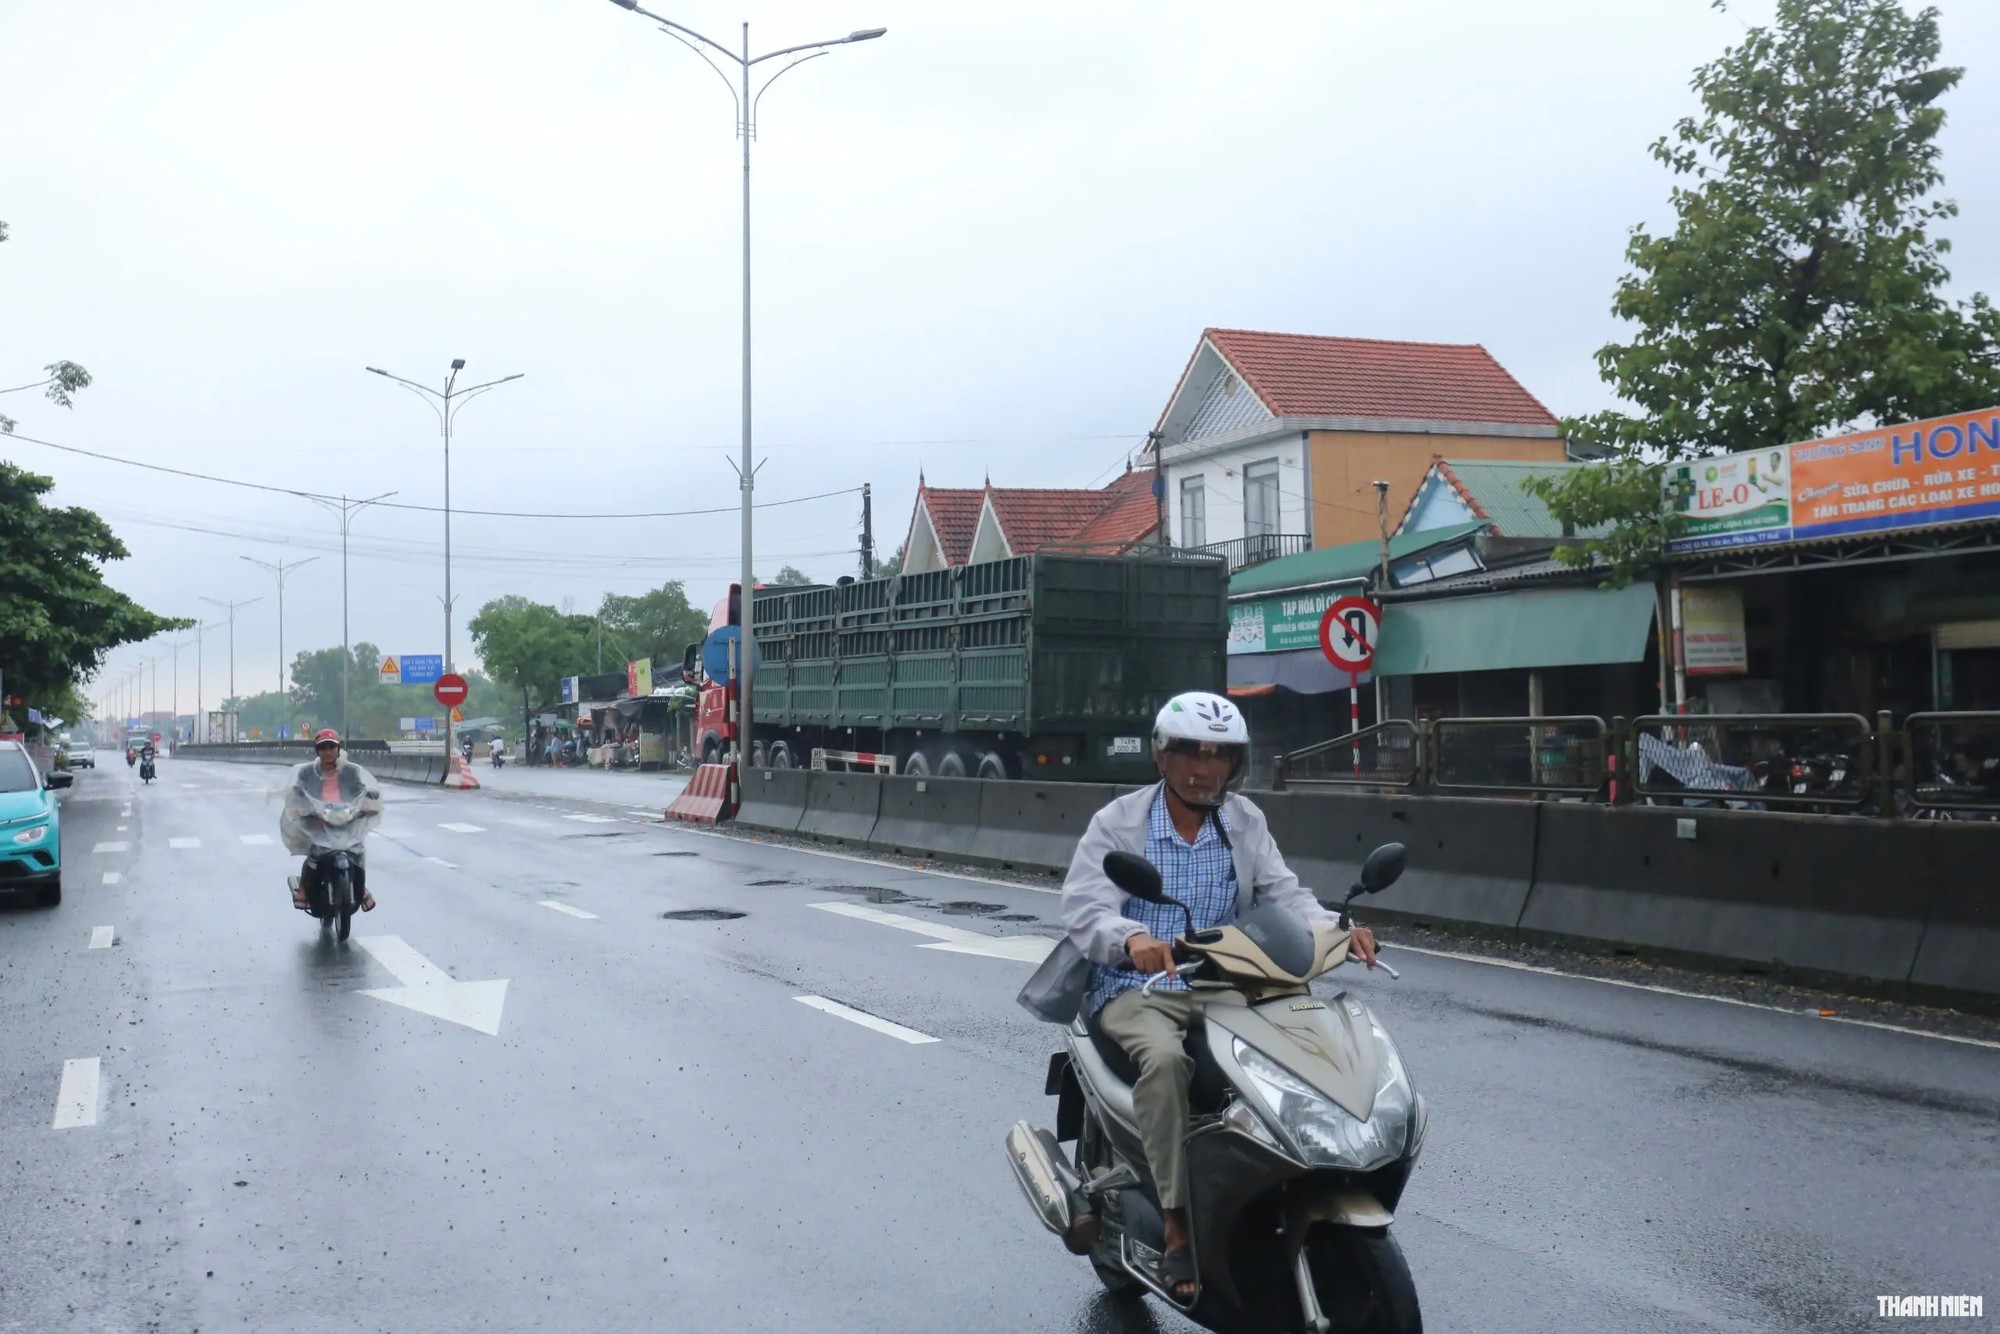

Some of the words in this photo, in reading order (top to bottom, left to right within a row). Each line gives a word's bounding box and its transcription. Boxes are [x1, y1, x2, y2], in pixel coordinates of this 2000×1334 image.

[1891, 417, 2000, 466] HON
[1697, 483, 1749, 510] LE-O
[1843, 481, 1869, 498] SỬA
[1924, 469, 1953, 486] RỬA
[1957, 468, 1977, 481] XE
[1813, 504, 1838, 518] TÂN
[1842, 499, 1885, 514] TRANG
[1889, 493, 1917, 508] CÁC
[1920, 489, 1953, 504] LOẠI
[1957, 486, 1977, 500] XE
[1282, 601, 1297, 620] TẠP
[1298, 596, 1315, 614] HÓA
[1316, 593, 1325, 612] DÌ
